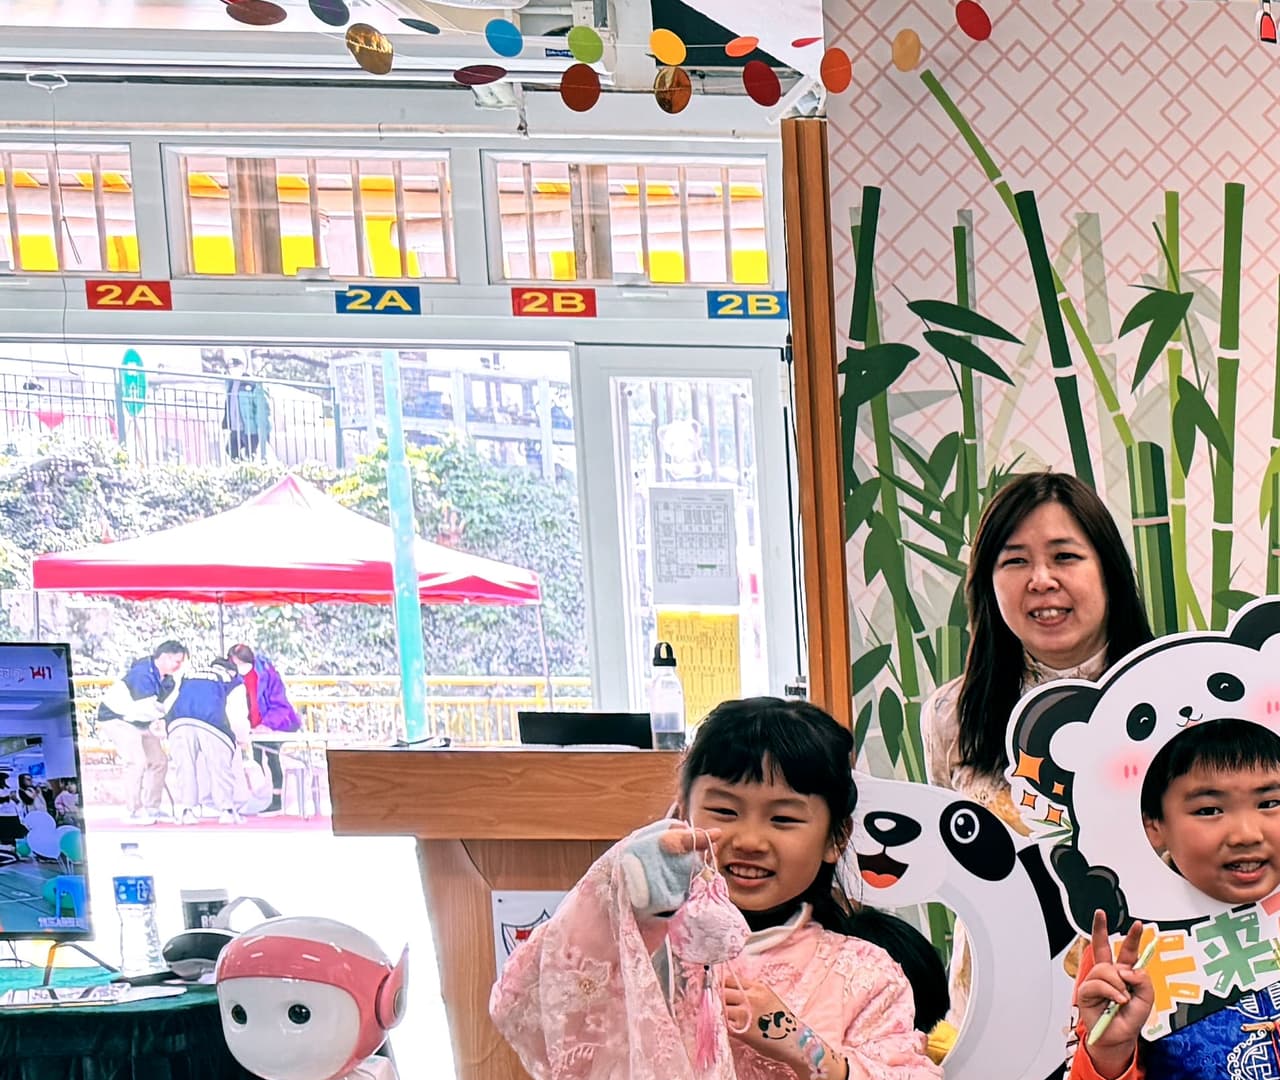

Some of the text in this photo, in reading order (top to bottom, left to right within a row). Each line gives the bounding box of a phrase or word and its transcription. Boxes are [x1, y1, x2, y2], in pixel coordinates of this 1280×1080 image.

[95, 284, 164, 306] 2A
[345, 289, 413, 312] 2A
[520, 291, 587, 313] 2B
[716, 293, 782, 316] 2B
